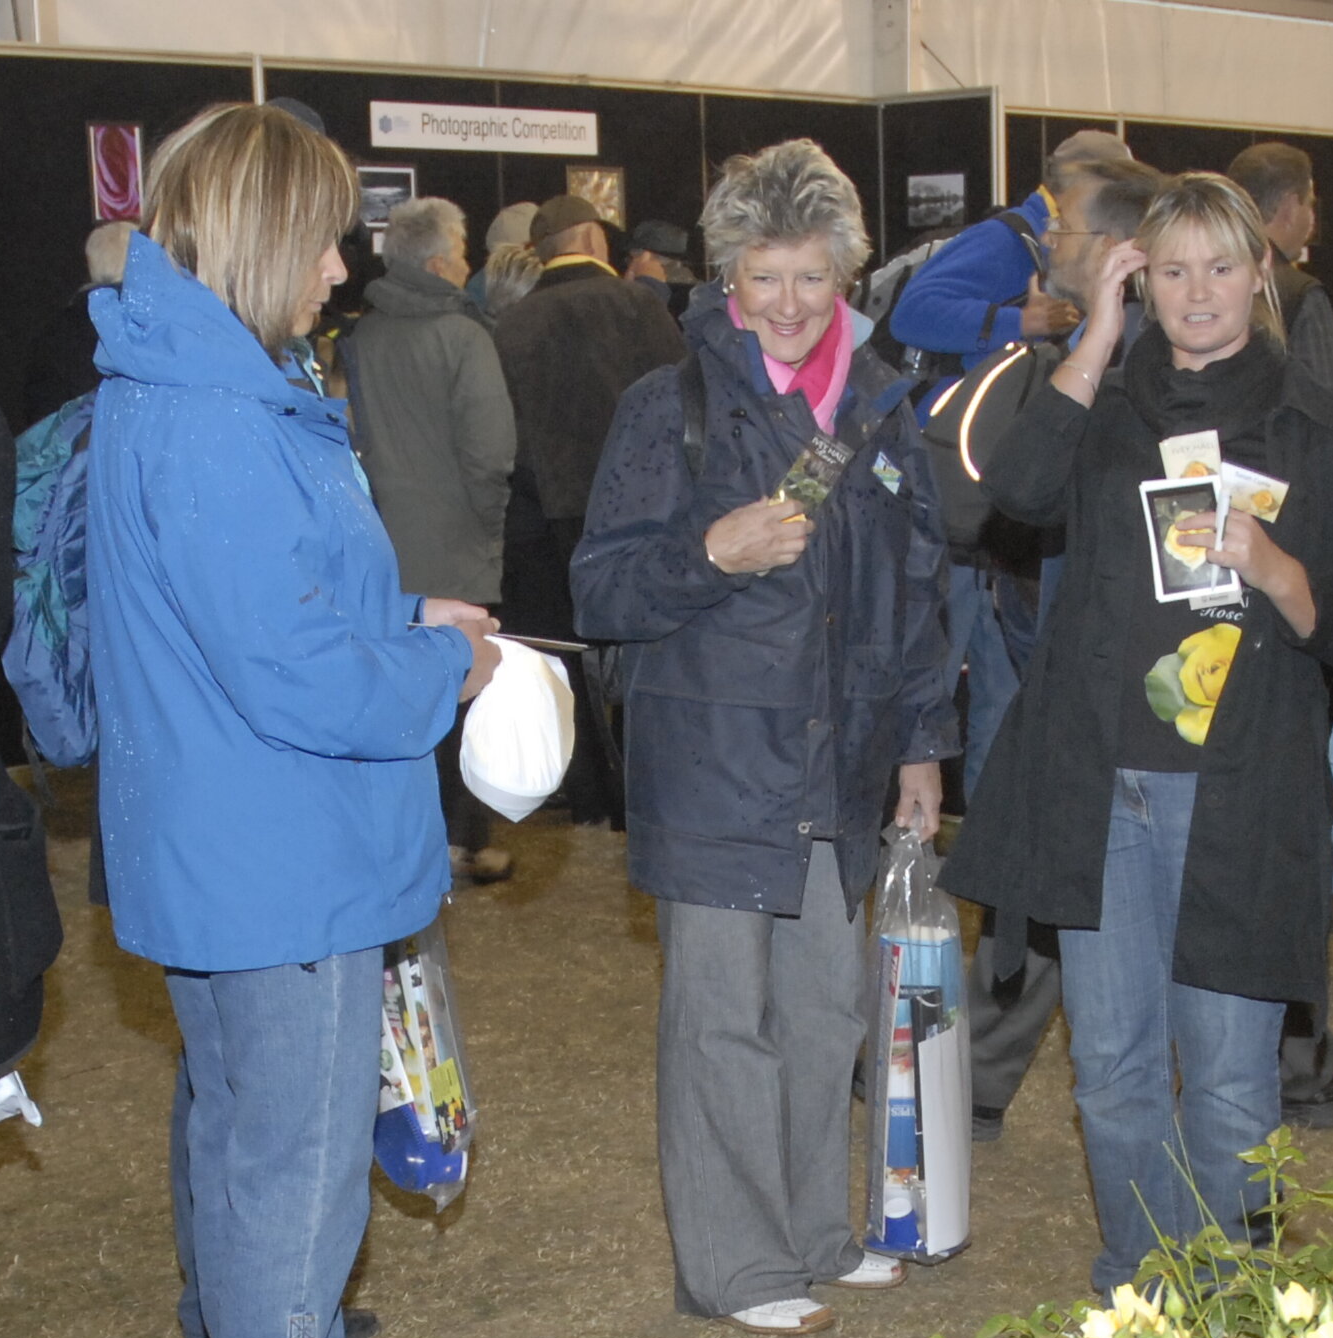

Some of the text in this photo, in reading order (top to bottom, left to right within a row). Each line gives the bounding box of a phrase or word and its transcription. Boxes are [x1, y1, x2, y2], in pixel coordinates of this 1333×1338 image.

[421, 113, 508, 141] Photographic
[512, 116, 587, 144] Competition
[1200, 608, 1243, 621] Rose
